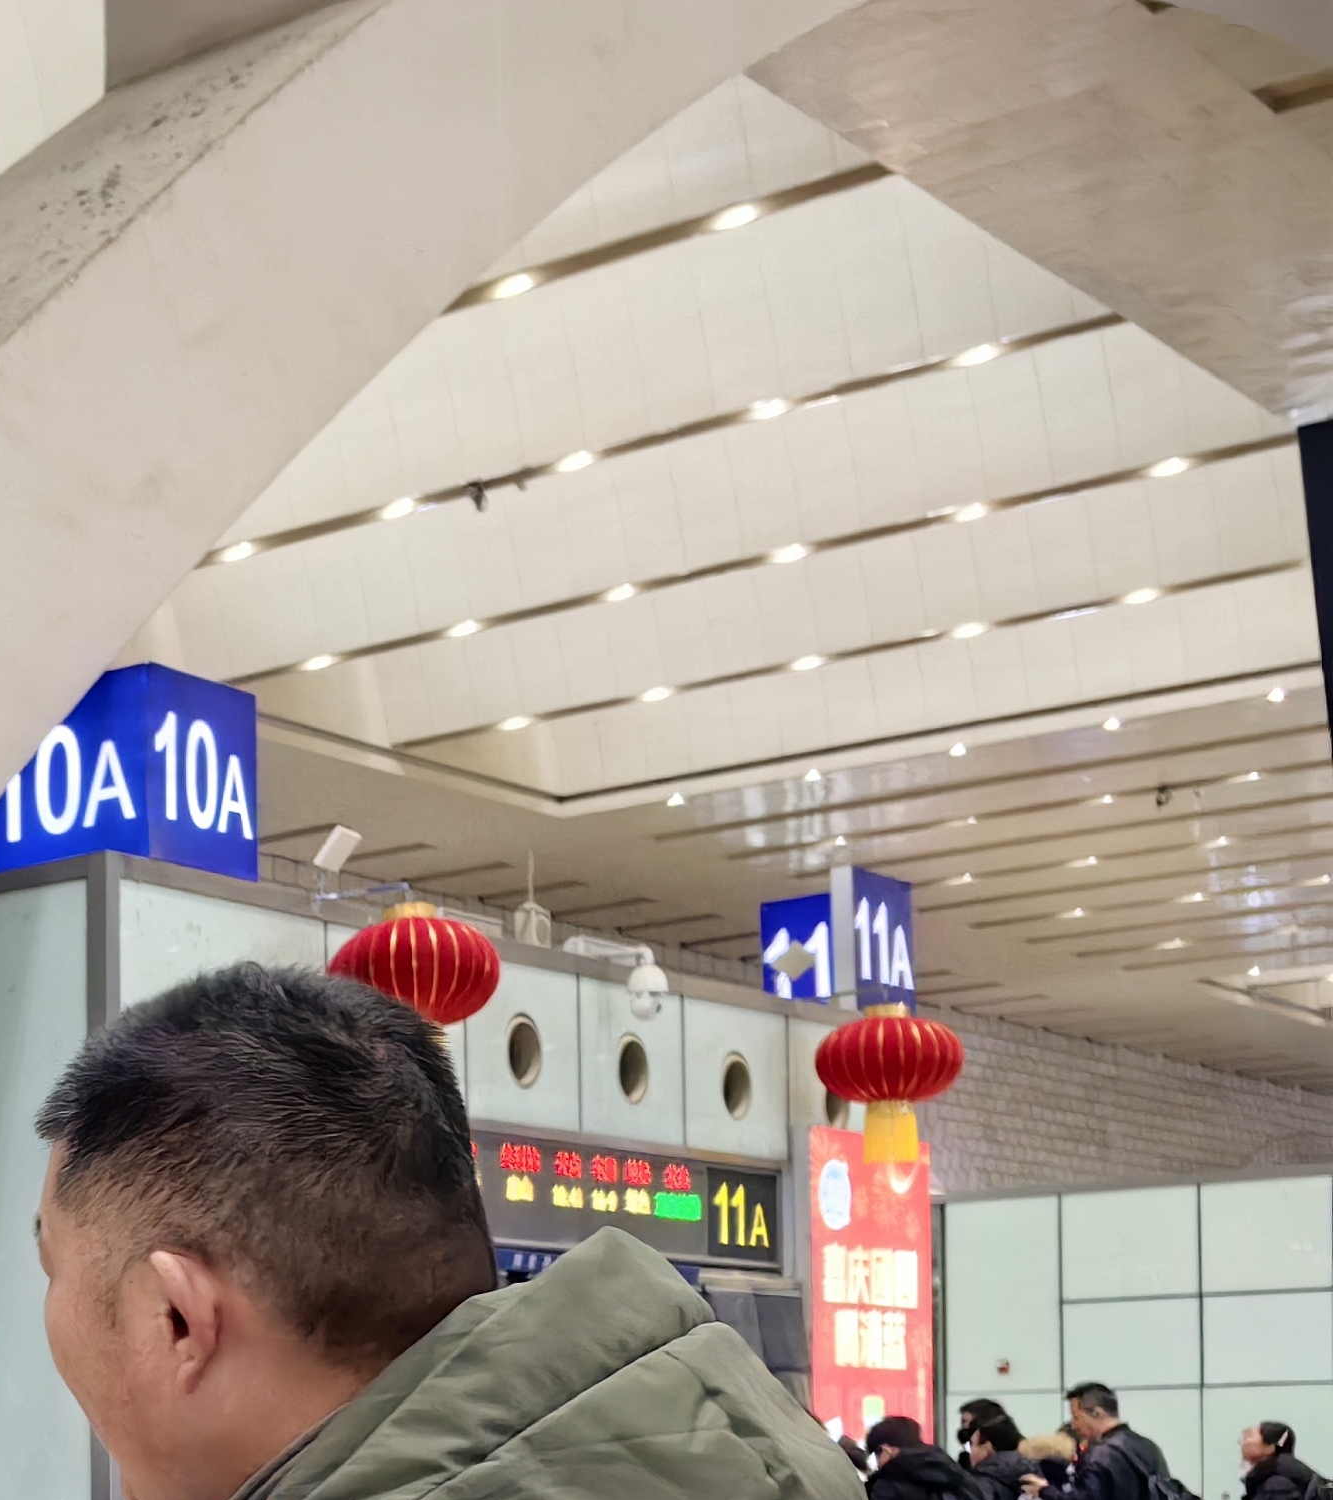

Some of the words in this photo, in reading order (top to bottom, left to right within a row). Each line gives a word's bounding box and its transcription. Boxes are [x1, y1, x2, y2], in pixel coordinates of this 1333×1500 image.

[153, 710, 255, 841] 10A
[854, 896, 915, 991] 11A
[713, 1181, 770, 1249] 11A
